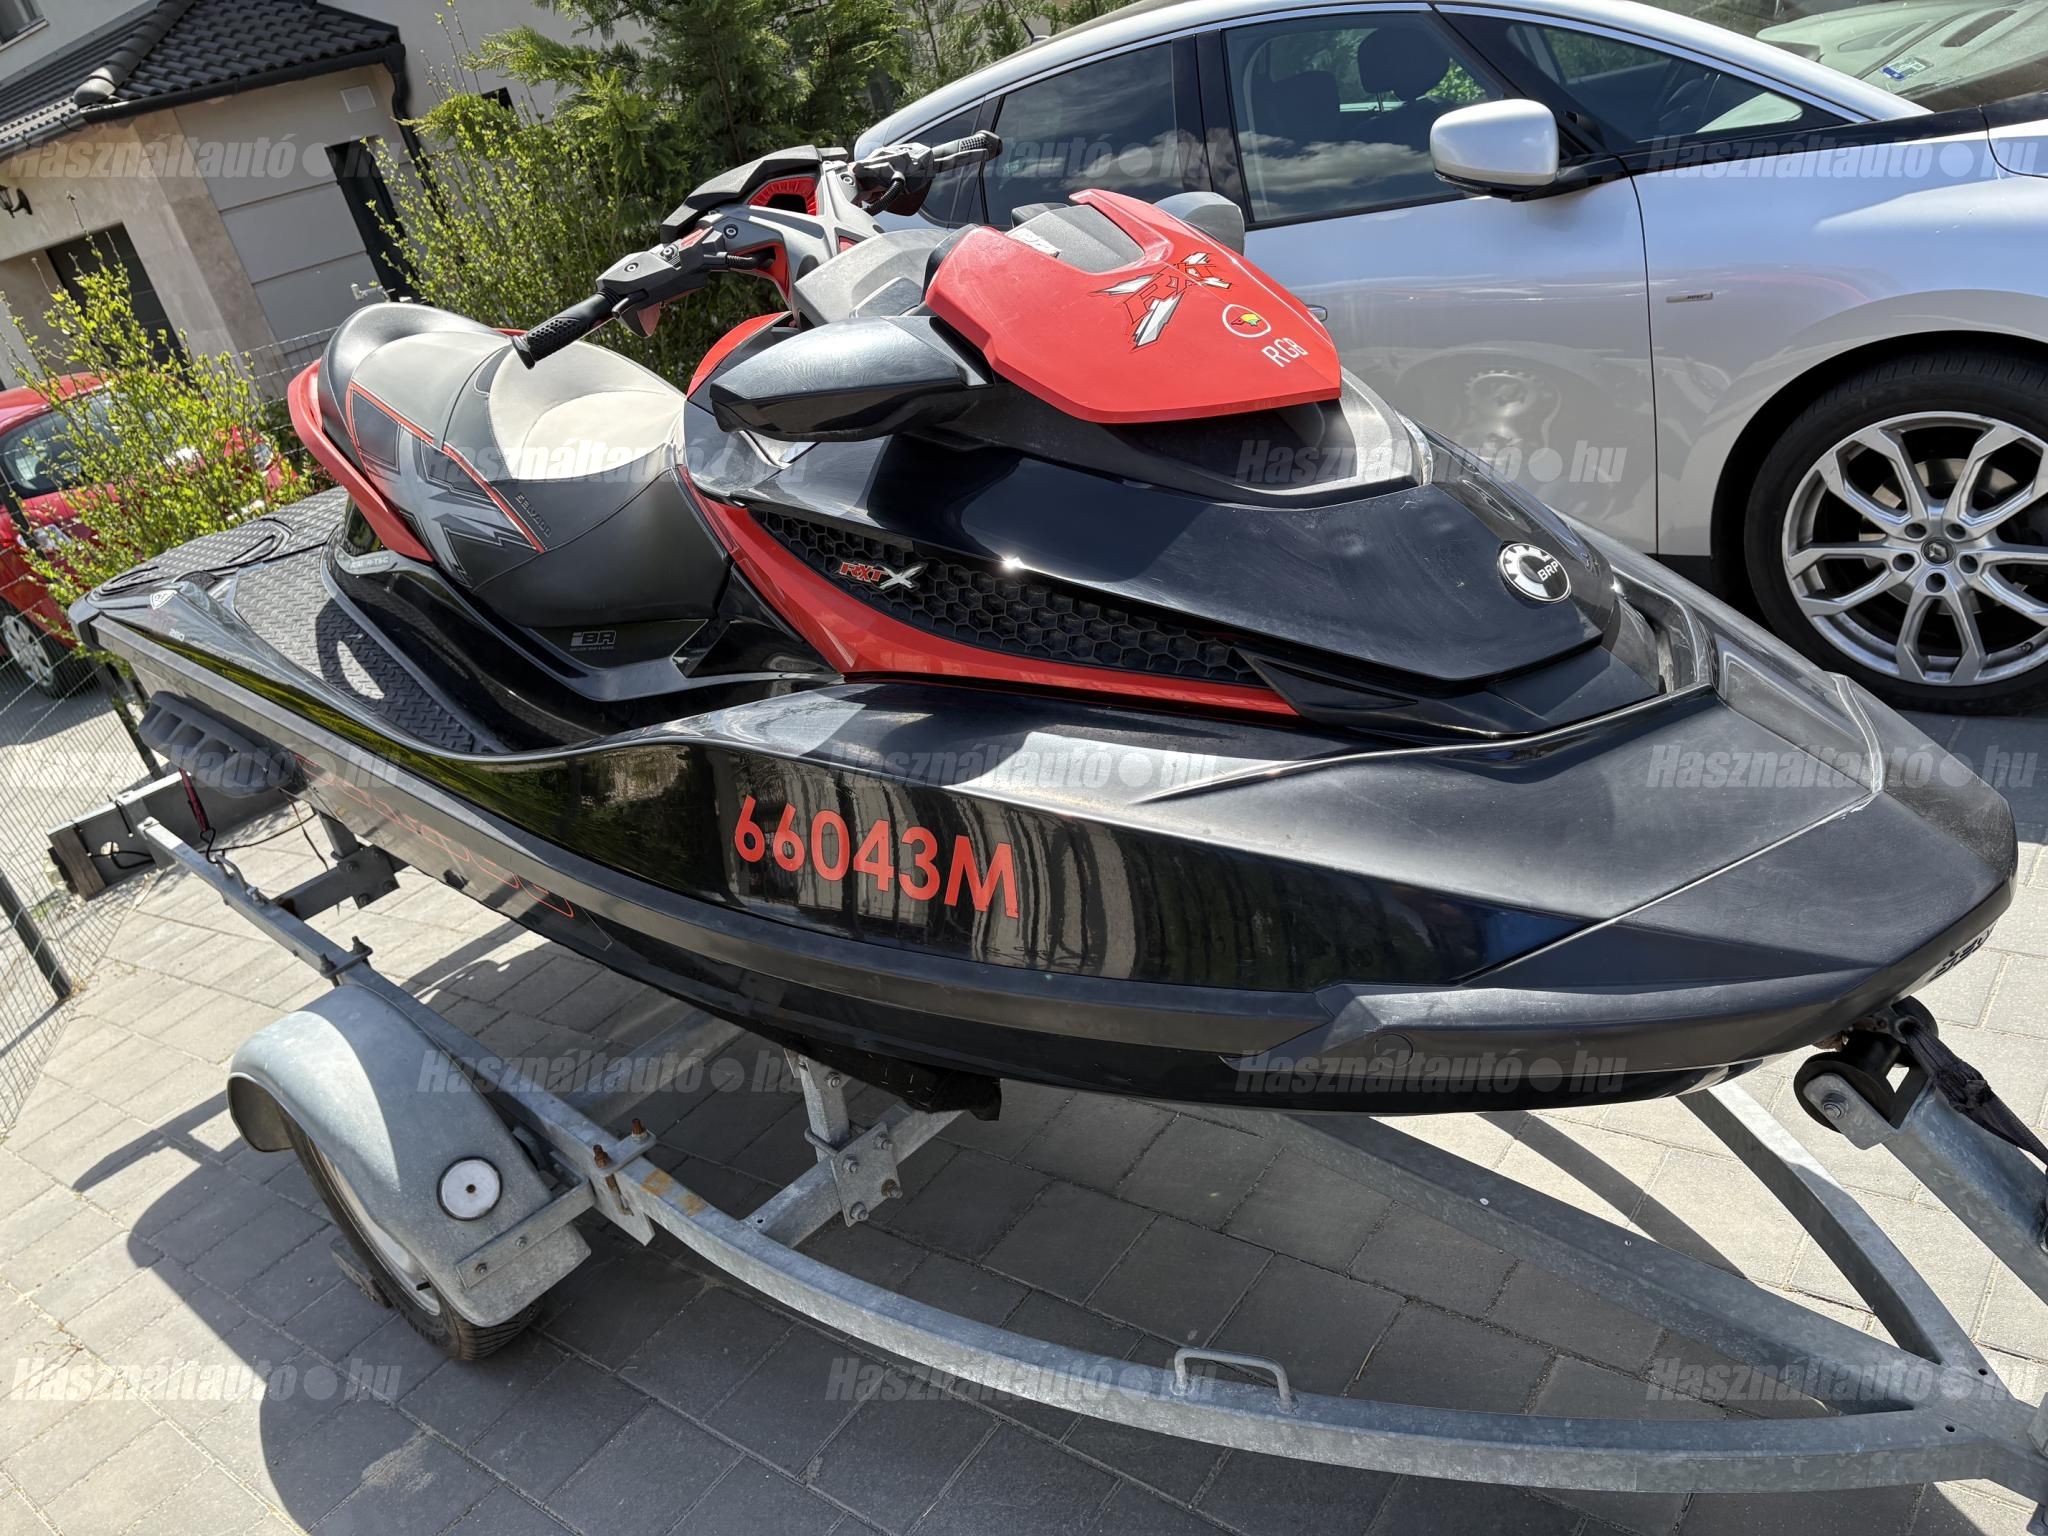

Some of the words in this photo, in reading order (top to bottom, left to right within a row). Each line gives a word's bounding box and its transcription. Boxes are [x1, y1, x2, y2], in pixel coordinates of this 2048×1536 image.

[1262, 337, 1309, 367] RGB
[1537, 561, 1559, 582] BRP
[734, 795, 1020, 919] 66043M
